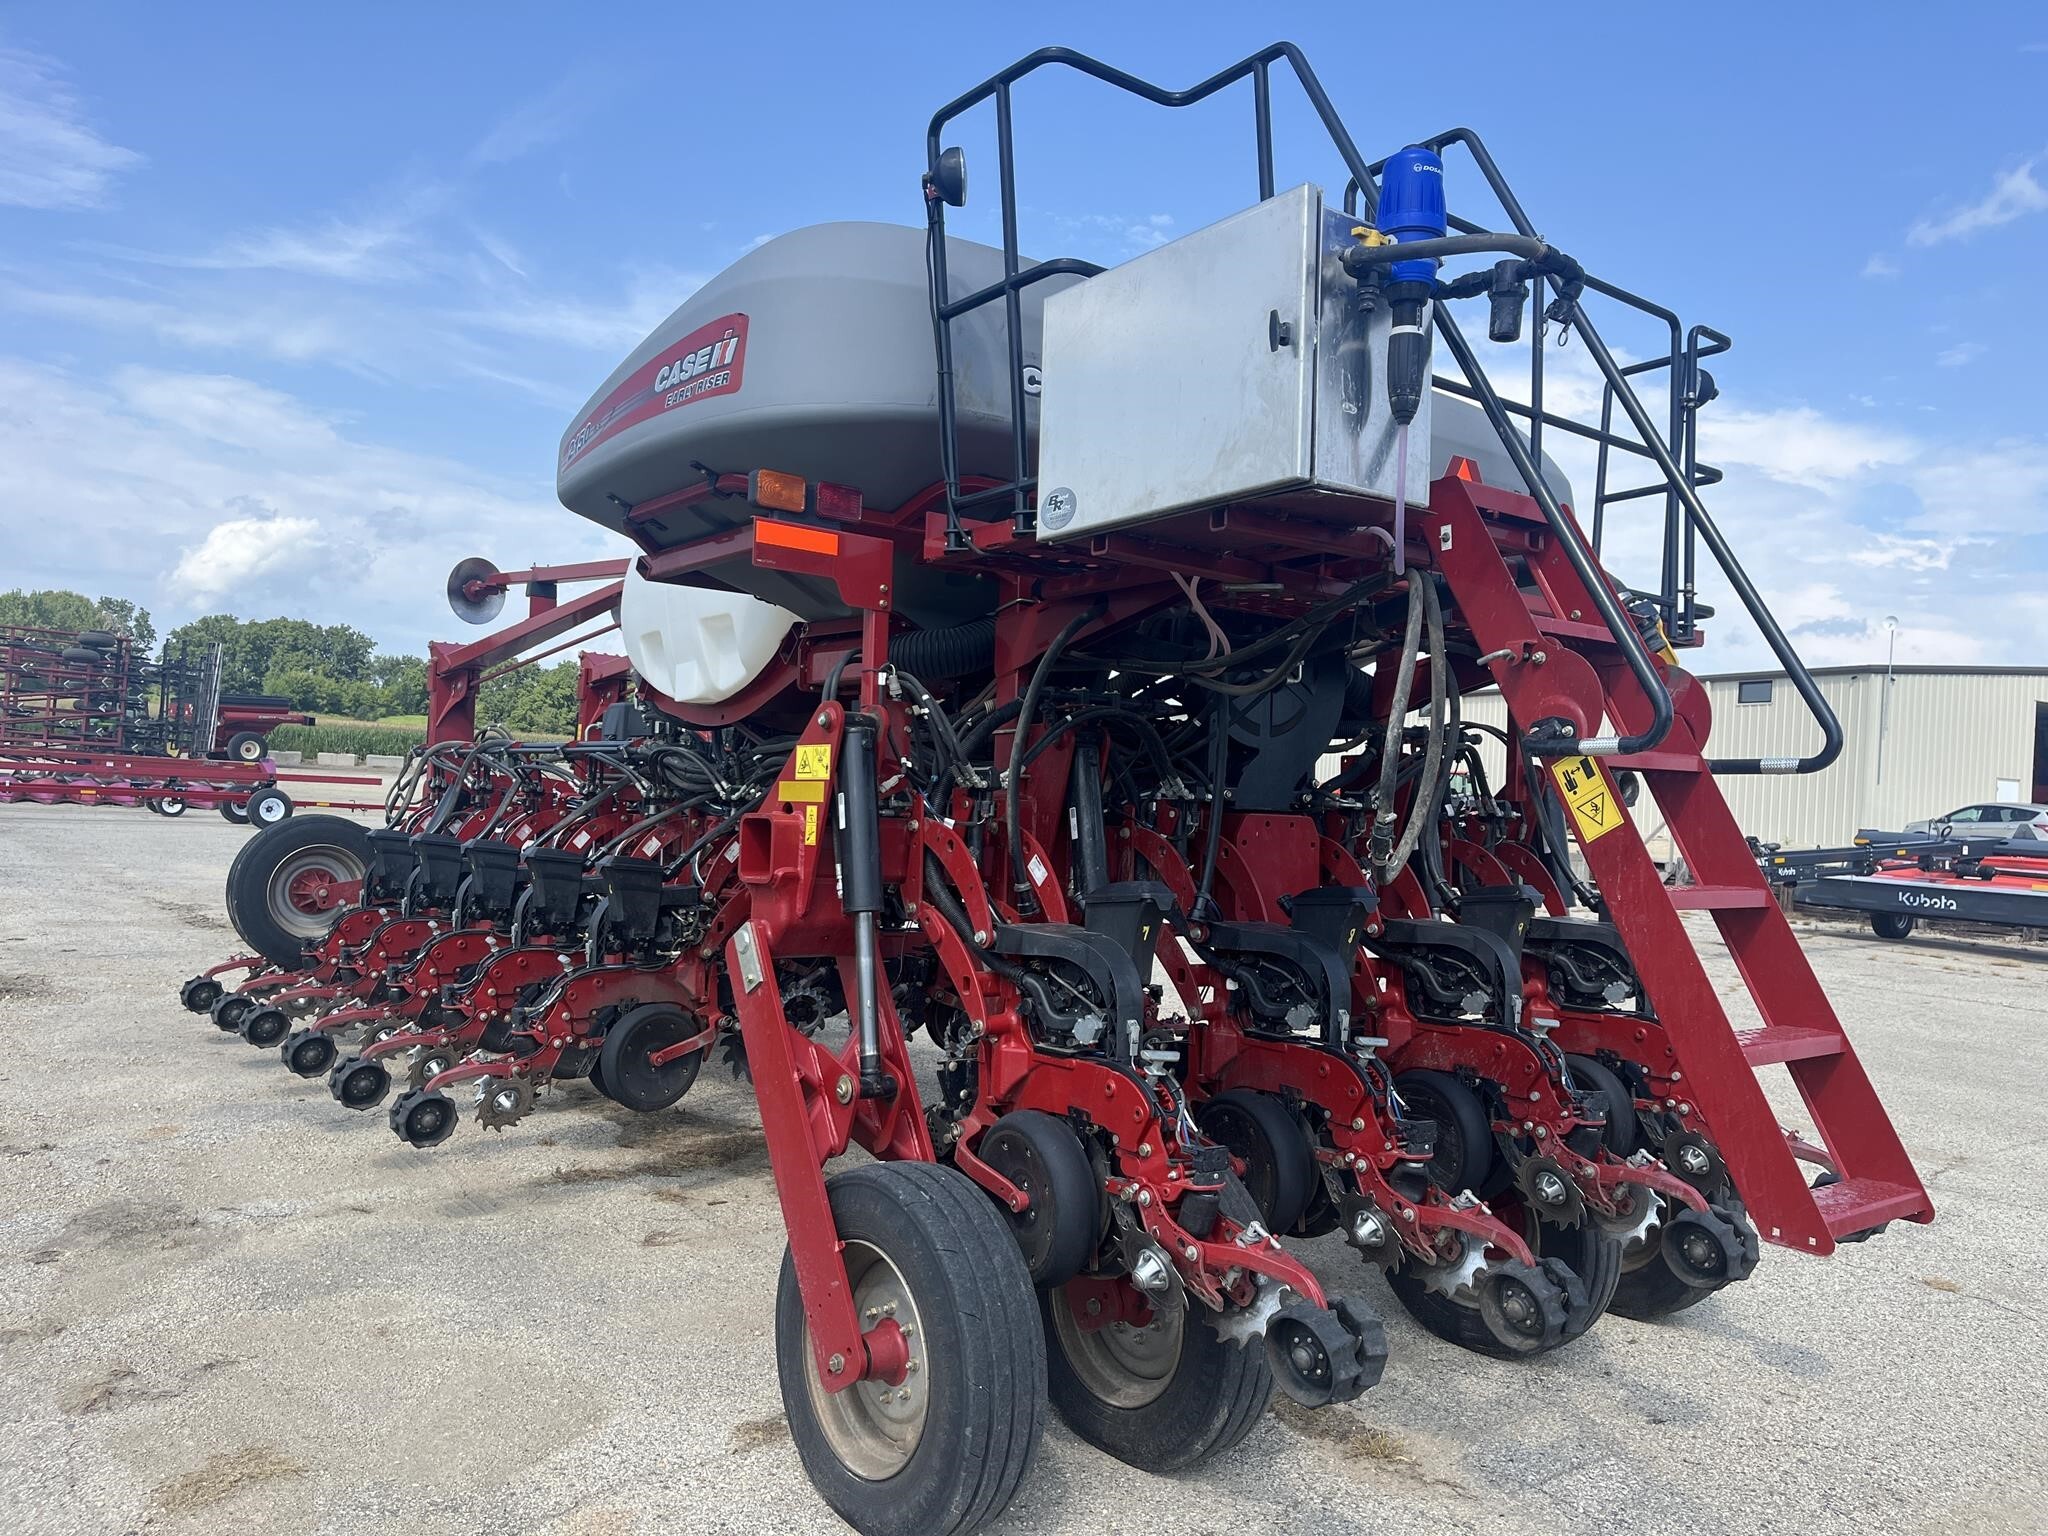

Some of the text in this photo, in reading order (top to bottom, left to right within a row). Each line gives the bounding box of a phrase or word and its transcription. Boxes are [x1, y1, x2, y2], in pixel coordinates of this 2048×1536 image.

[664, 370, 731, 408] EARLY RISER
[1898, 891, 1957, 910] Kubota
[1142, 925, 1151, 941] 7
